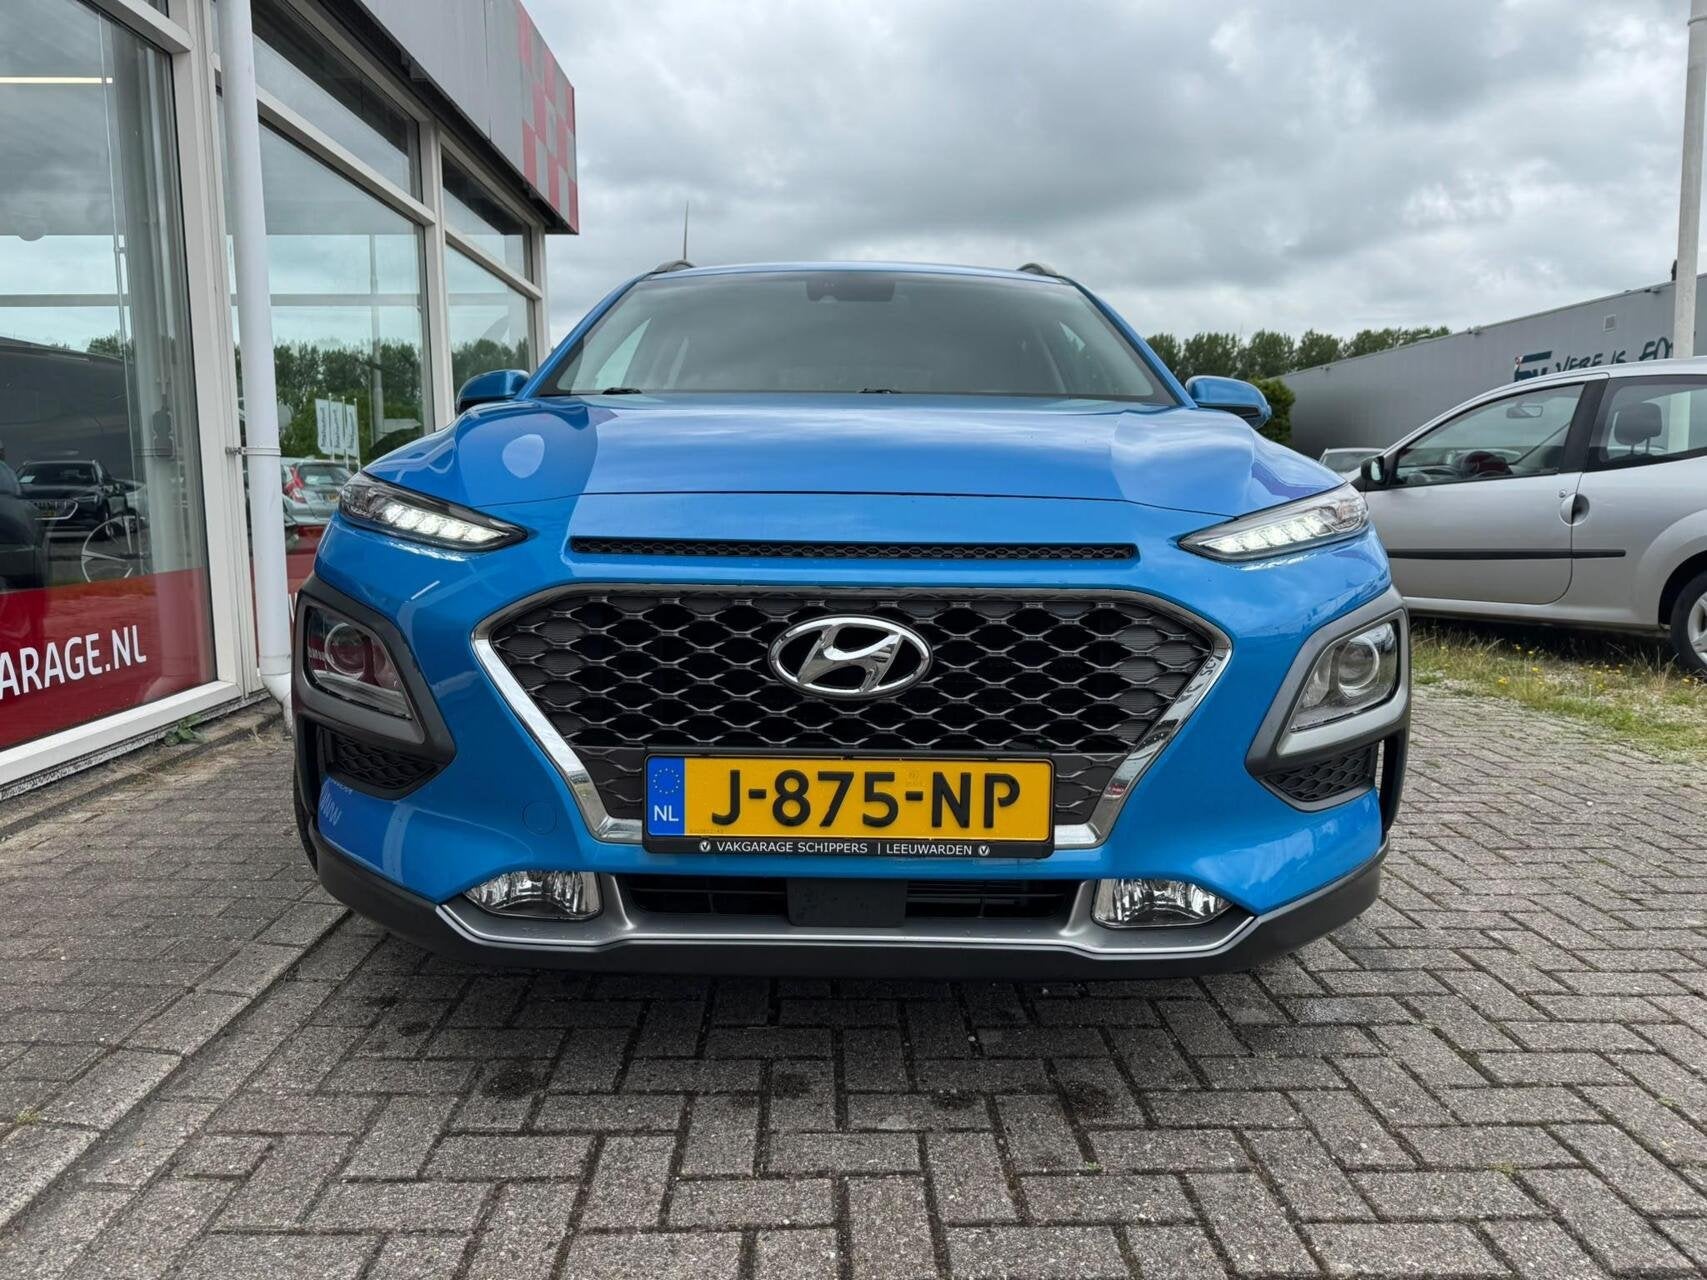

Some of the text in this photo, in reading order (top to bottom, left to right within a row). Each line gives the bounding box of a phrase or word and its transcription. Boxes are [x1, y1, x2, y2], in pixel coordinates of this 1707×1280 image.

[0, 625, 147, 700] ARAGE.NL
[653, 805, 679, 823] NL
[711, 769, 1020, 828] J-875-NP
[716, 841, 794, 853] VAKGARAGE
[798, 842, 868, 854] SCHIPPERS
[886, 843, 972, 856] LEEUWARDEN
